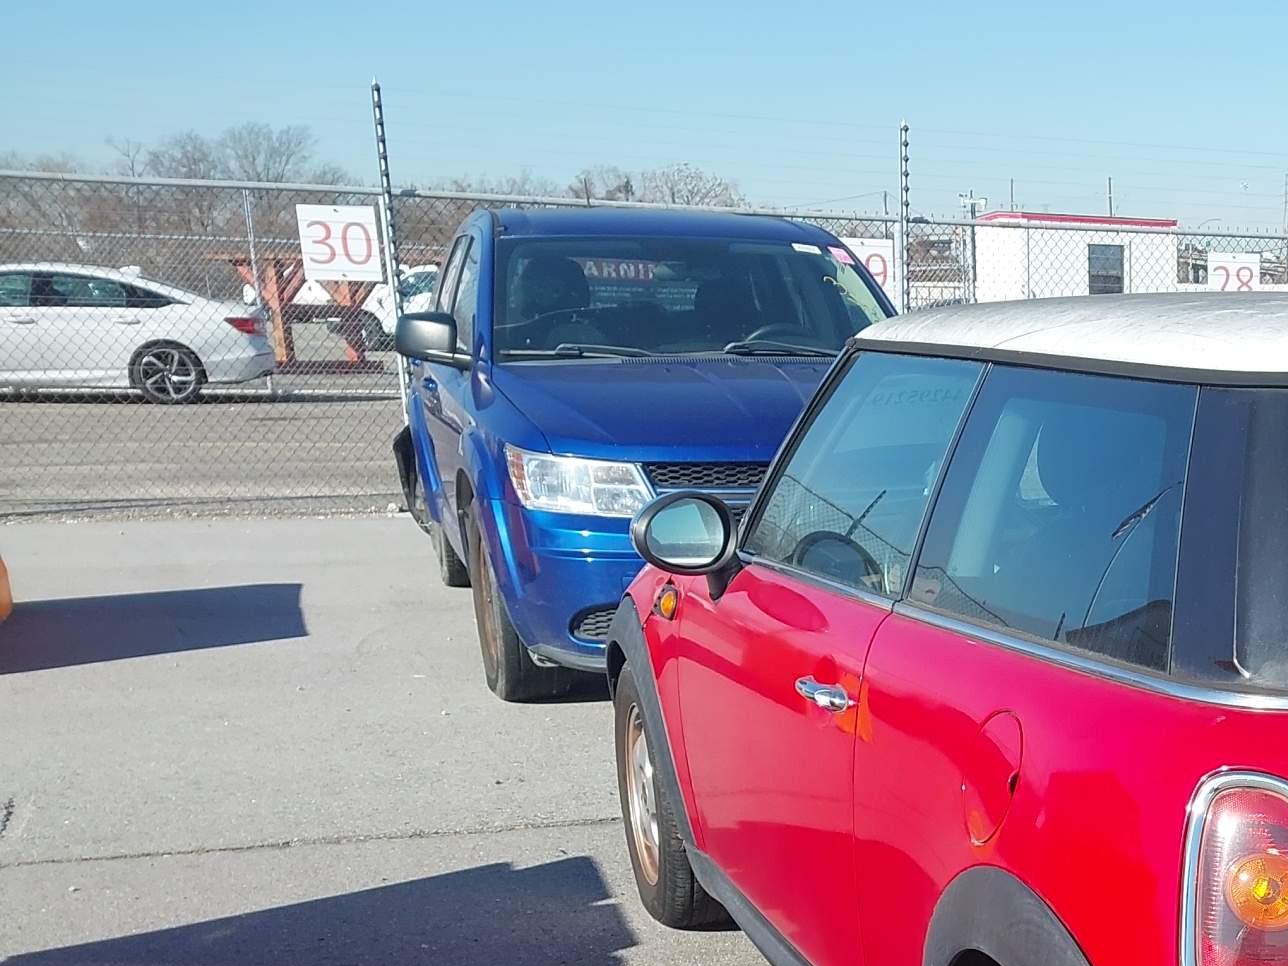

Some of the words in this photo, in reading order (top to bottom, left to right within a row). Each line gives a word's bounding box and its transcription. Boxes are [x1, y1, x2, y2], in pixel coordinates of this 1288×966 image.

[306, 220, 373, 266] 30
[864, 252, 888, 288] 9
[1213, 265, 1254, 292] 28
